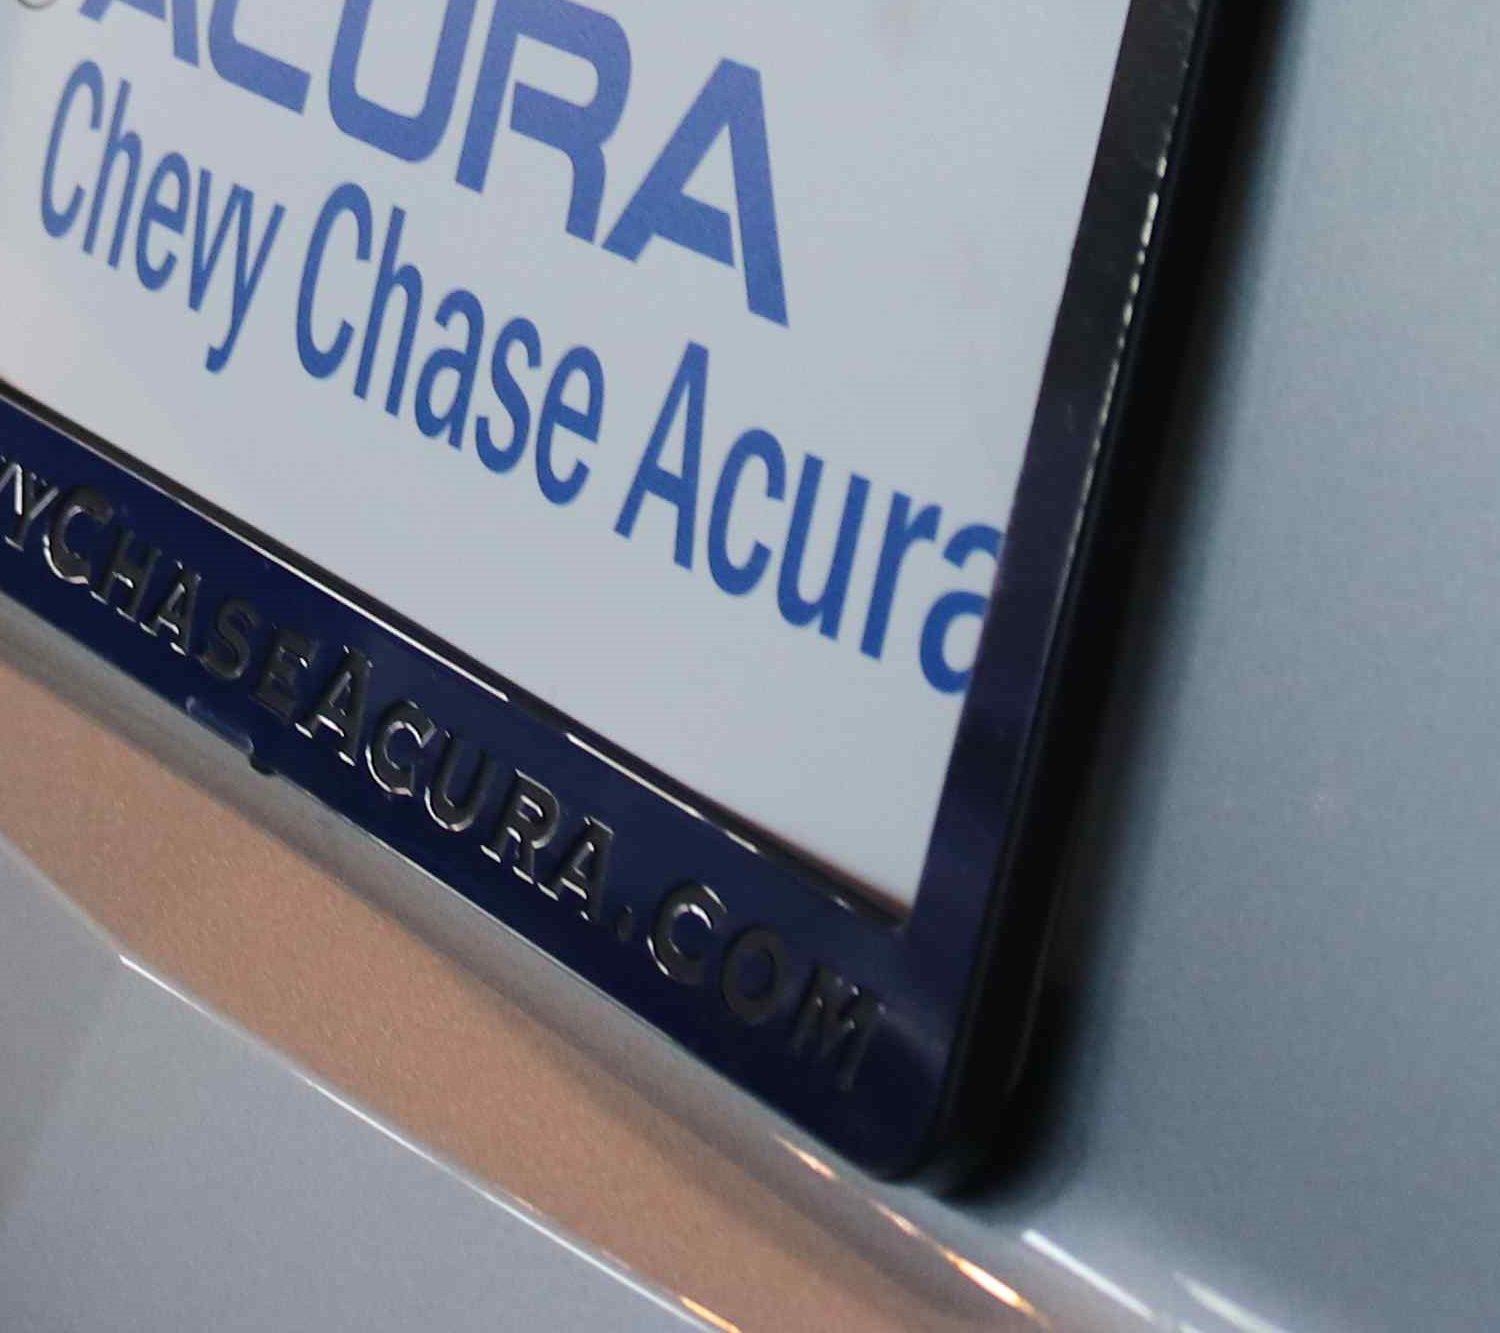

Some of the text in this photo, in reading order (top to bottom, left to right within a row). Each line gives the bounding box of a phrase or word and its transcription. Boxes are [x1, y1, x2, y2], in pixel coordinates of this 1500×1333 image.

[36, 57, 1006, 697] Chevy Chase Acura
